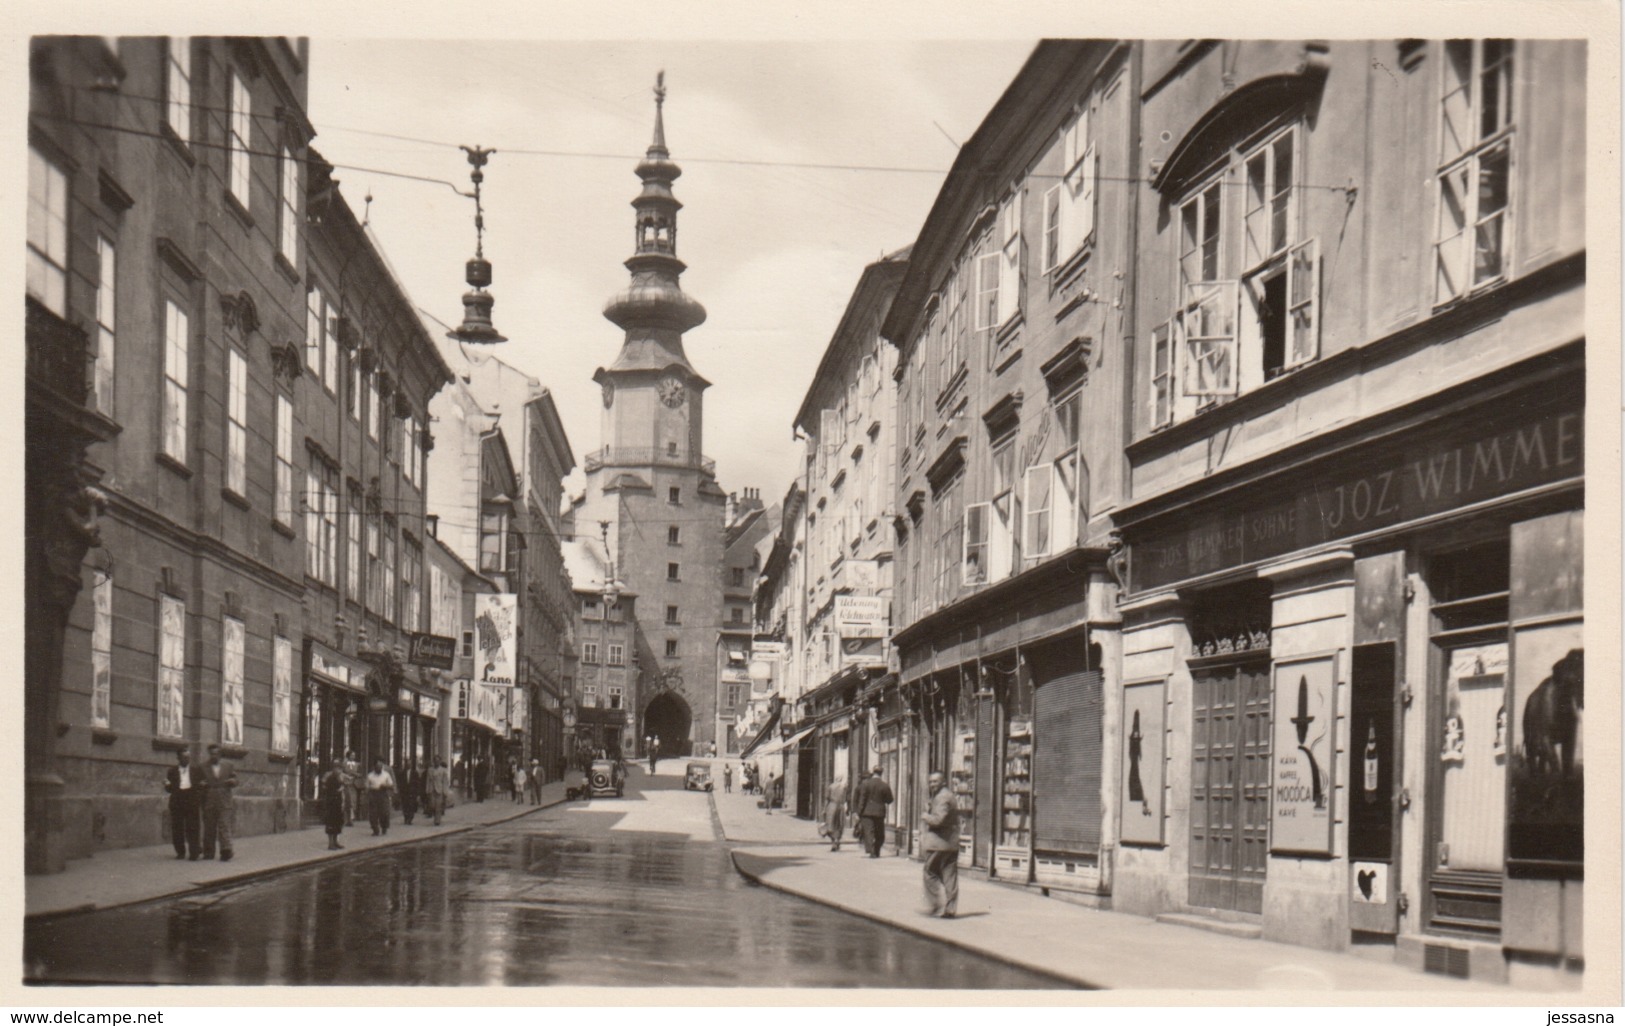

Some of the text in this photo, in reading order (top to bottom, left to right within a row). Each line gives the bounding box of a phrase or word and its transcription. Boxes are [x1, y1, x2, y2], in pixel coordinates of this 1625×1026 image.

[1328, 412, 1577, 528] JOZ. WIMME
[480, 662, 512, 685] Lana
